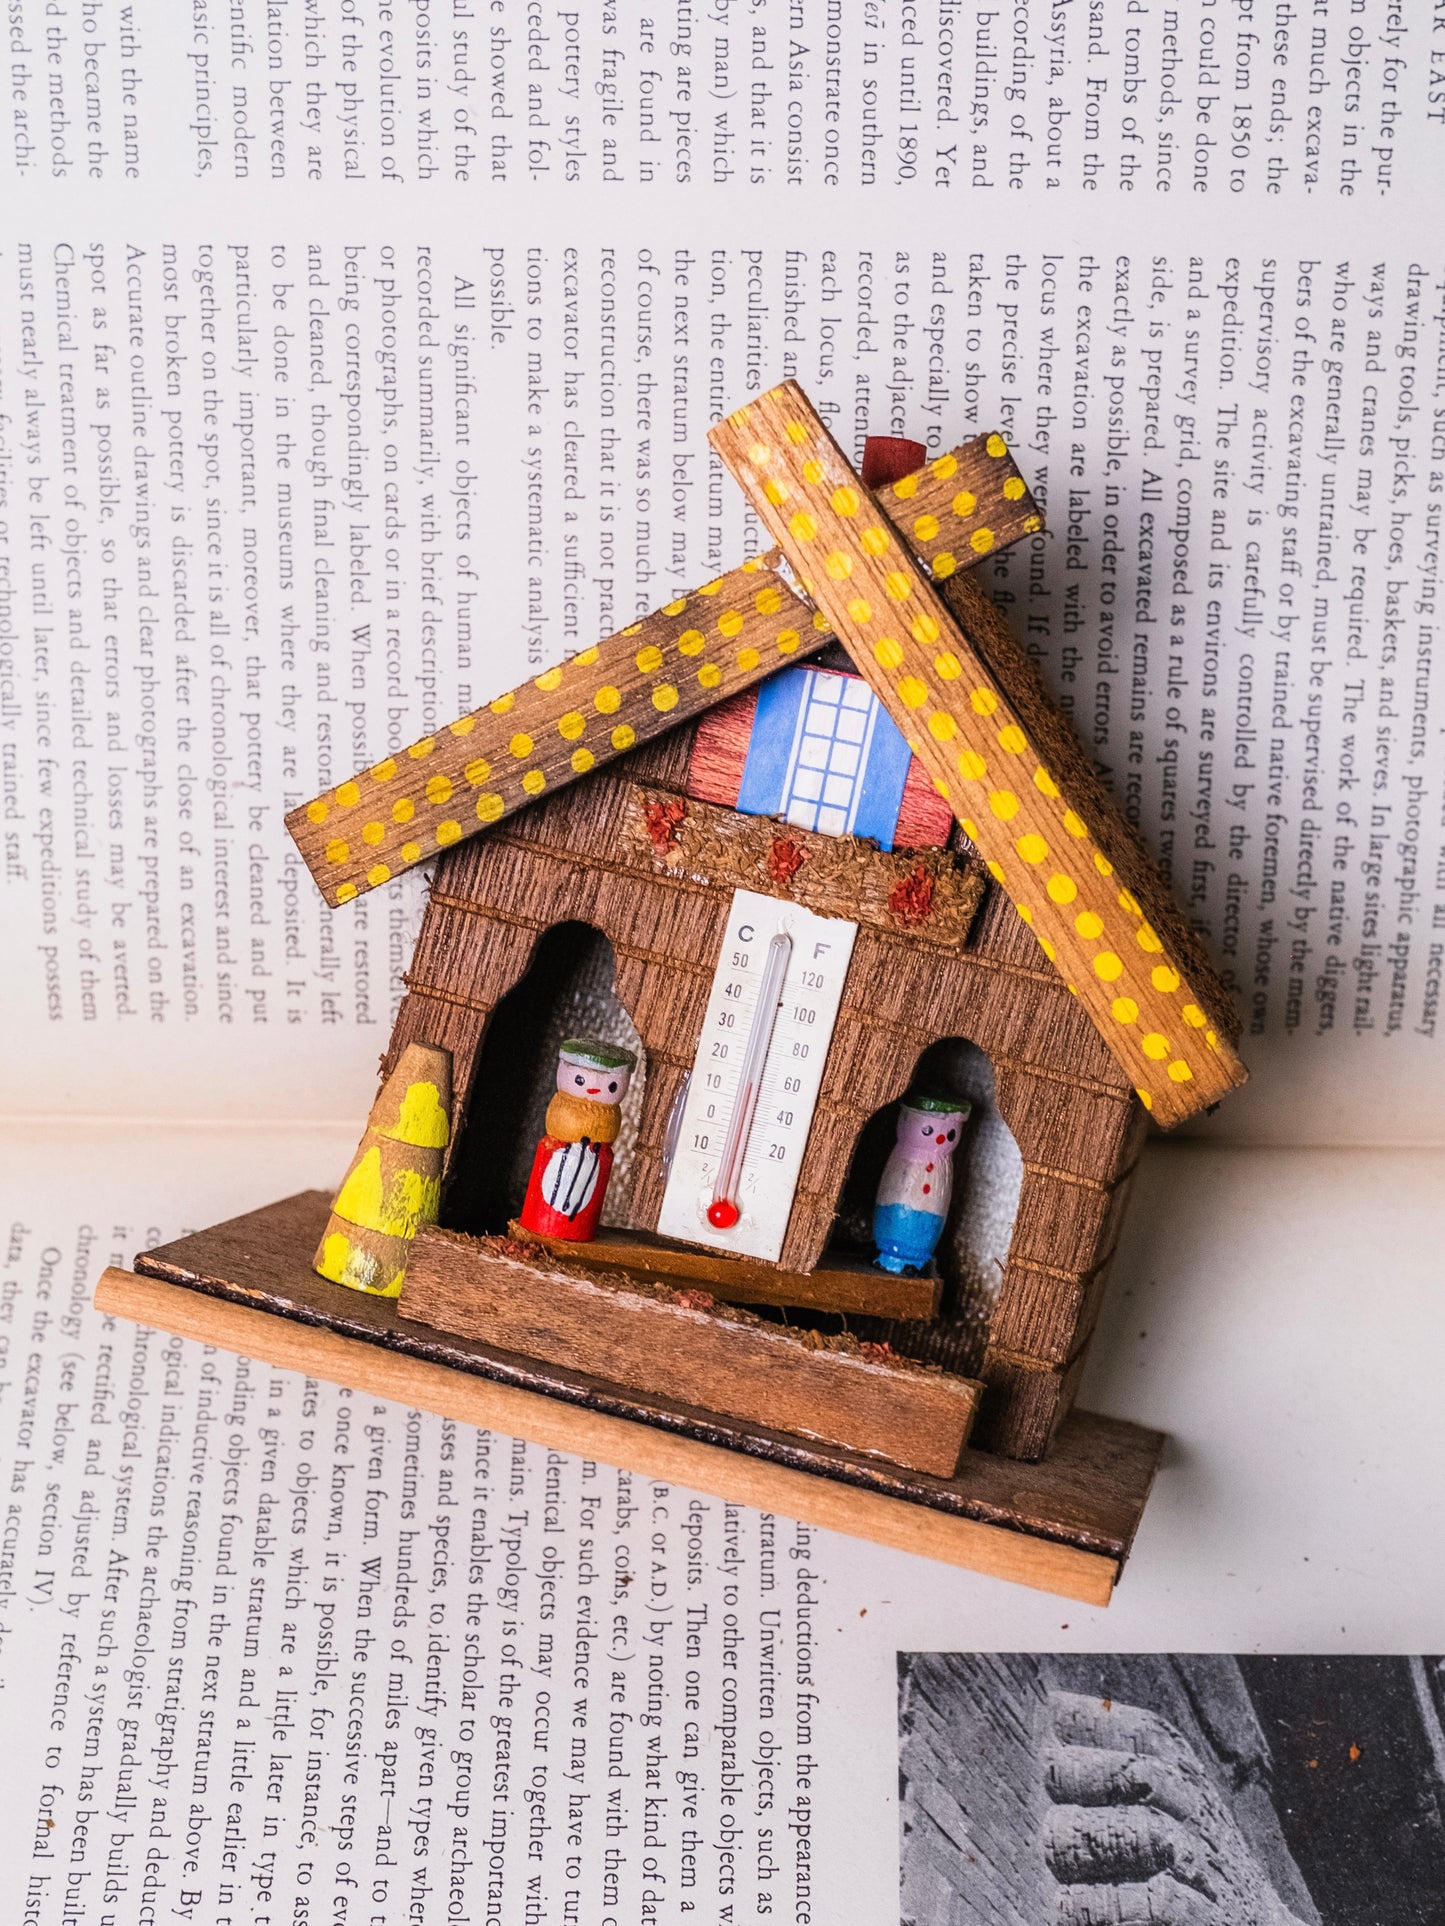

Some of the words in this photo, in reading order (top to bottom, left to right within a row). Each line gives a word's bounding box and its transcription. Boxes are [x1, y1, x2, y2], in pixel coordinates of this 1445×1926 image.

[46, 26, 68, 64] the
[120, 5, 142, 58] with
[557, 11, 581, 100] pottery
[640, 18, 654, 53] are
[752, 26, 774, 70] and
[1087, 1, 1110, 63] sand.
[1273, 3, 1298, 66] these
[446, 30, 476, 97] study
[900, 56, 922, 113] until
[969, 11, 1000, 134] buildings,
[1155, 9, 1184, 123] methods,
[1235, 32, 1260, 91] from
[1382, 57, 1407, 93] for
[121, 68, 143, 106] the
[300, 82, 327, 133] they
[639, 70, 663, 142] found
[751, 81, 773, 130] that
[1085, 76, 1108, 141] From
[1265, 78, 1293, 142] ends;
[1427, 50, 1445, 125] EAST
[49, 73, 74, 177] methods
[187, 53, 219, 178] principles,
[454, 108, 477, 136] of
[1231, 104, 1253, 159] 1850
[1380, 101, 1403, 139] the
[124, 114, 139, 178] name
[307, 146, 322, 180] are
[455, 144, 476, 182] the
[558, 115, 587, 181] styles
[750, 139, 772, 157] it
[894, 124, 919, 185] 1890,
[972, 144, 994, 187] and
[1156, 132, 1179, 192] since
[1371, 145, 1394, 196] pur-
[640, 160, 661, 183] in
[750, 166, 772, 184] is
[1082, 153, 1105, 191] the
[1230, 169, 1246, 193] to
[1266, 156, 1289, 194] the
[54, 243, 79, 351] Chemical
[192, 244, 221, 344] together
[483, 247, 515, 349] possible.
[563, 248, 579, 360] excavator
[1332, 261, 1356, 311] who
[1216, 258, 1245, 390] expedition.
[1330, 318, 1346, 353] are
[1394, 263, 1430, 359] drawing
[201, 351, 216, 380] on
[564, 371, 585, 408] has
[59, 364, 77, 474] treatment
[203, 389, 224, 425] the
[1316, 358, 1346, 465] generally
[1393, 366, 1420, 430] tools,
[1216, 403, 1239, 449] The
[197, 433, 220, 488] spot,
[564, 421, 586, 500] cleared
[1213, 459, 1235, 499] site
[1388, 436, 1416, 504] picks,
[64, 485, 87, 511] of
[564, 512, 578, 523] a
[206, 498, 227, 555] since
[1210, 509, 1232, 551] and
[1311, 473, 1340, 589] untrained,
[1384, 512, 1412, 570] hoes,
[60, 518, 88, 598] objects
[208, 563, 228, 578] it
[1208, 563, 1231, 589] its
[209, 587, 229, 602] is
[564, 534, 586, 638] sufficient
[69, 609, 90, 649] and
[210, 611, 231, 636] all
[1311, 597, 1328, 654] must
[1377, 581, 1410, 670] baskets,
[210, 645, 232, 670] of
[1202, 600, 1226, 697] environs
[1309, 661, 1333, 687] be
[1378, 677, 1400, 718] and
[70, 661, 93, 748] detailed
[1200, 708, 1216, 742] are
[206, 675, 234, 829] chronological
[1299, 693, 1325, 811] supervised
[1373, 726, 1397, 796] sieves.
[73, 760, 95, 858] technical
[1189, 751, 1216, 849] surveyed
[1370, 804, 1392, 827] In
[214, 838, 234, 918] interest
[1288, 818, 1322, 901] directly
[1360, 833, 1391, 887] large
[72, 869, 98, 928] study
[1189, 860, 1216, 909] first,
[738, 925, 755, 942] C
[1287, 907, 1318, 933] by
[1362, 891, 1386, 939] sites
[79, 938, 101, 963] of
[216, 926, 238, 964] and
[732, 952, 749, 968] 50
[813, 942, 831, 959] F
[1290, 939, 1313, 973] the
[1352, 943, 1383, 994] light
[80, 970, 100, 1021] them
[217, 972, 237, 1024] since
[725, 983, 742, 998] 40
[801, 971, 824, 989] 120
[718, 1011, 735, 1028] 30
[793, 1006, 816, 1024] 100
[1352, 997, 1375, 1036] rail-
[711, 1042, 729, 1058] 20
[792, 1042, 809, 1058] 80
[706, 1073, 722, 1089] 10
[784, 1076, 801, 1093] 60
[707, 1104, 715, 1118] 0
[777, 1110, 794, 1126] 40
[694, 1134, 709, 1150] 10
[769, 1143, 786, 1160] 20
[60, 1224, 98, 1340] chronology
[59, 1353, 85, 1392] (see
[45, 1403, 79, 1470] below,
[334, 1406, 352, 1455] once
[475, 1429, 497, 1479] since
[323, 1464, 355, 1541] known,
[473, 1486, 495, 1501] it
[38, 1483, 62, 1556] section
[325, 1552, 347, 1567] it
[468, 1508, 494, 1584] enables
[680, 1500, 711, 1591] deposits.
[760, 1513, 780, 1598] stratum.
[26, 1570, 55, 1612] IV).
[322, 1576, 345, 1592] is
[466, 1592, 489, 1626] the
[686, 1603, 709, 1659] Then
[309, 1602, 339, 1696] possible,
[461, 1633, 486, 1712] scholar
[759, 1609, 781, 1720] Unwritten
[684, 1670, 701, 1710] one
[309, 1708, 335, 1740] for
[457, 1719, 477, 1742] to
[684, 1721, 700, 1758] can
[446, 1750, 473, 1818] group
[676, 1771, 704, 1819] give
[751, 1731, 778, 1817] objects,
[295, 1750, 330, 1849] instance,
[297, 1859, 315, 1888] to
[681, 1830, 704, 1889] them
[756, 1829, 777, 1881] such
[680, 1900, 695, 1914] a
[756, 1893, 772, 1914] as
